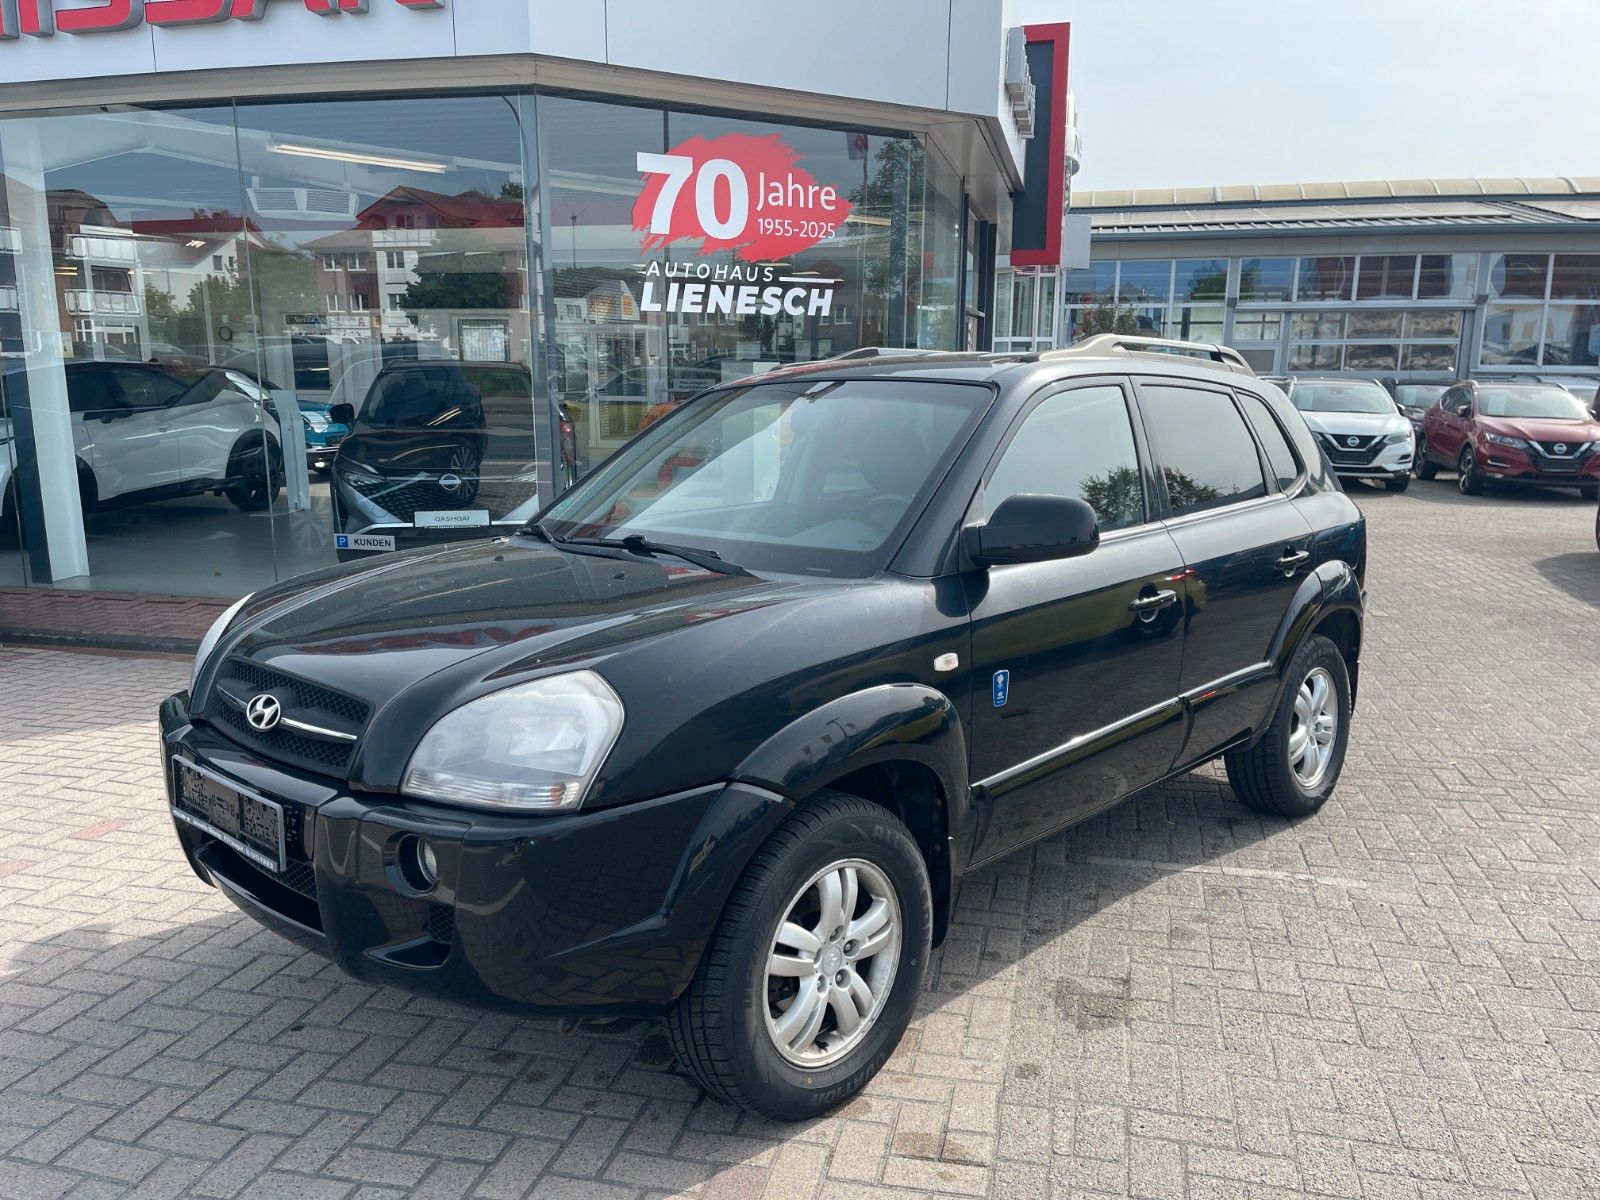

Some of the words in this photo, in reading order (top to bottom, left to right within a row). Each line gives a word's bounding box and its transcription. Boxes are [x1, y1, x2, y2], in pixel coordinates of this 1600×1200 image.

[636, 151, 749, 240] 70
[756, 172, 836, 211] Jahre
[757, 218, 836, 239] 1955-2025
[646, 261, 774, 282] AUTOHAUS
[640, 282, 833, 316] LIENESCH
[353, 538, 391, 547] KUNDEN
